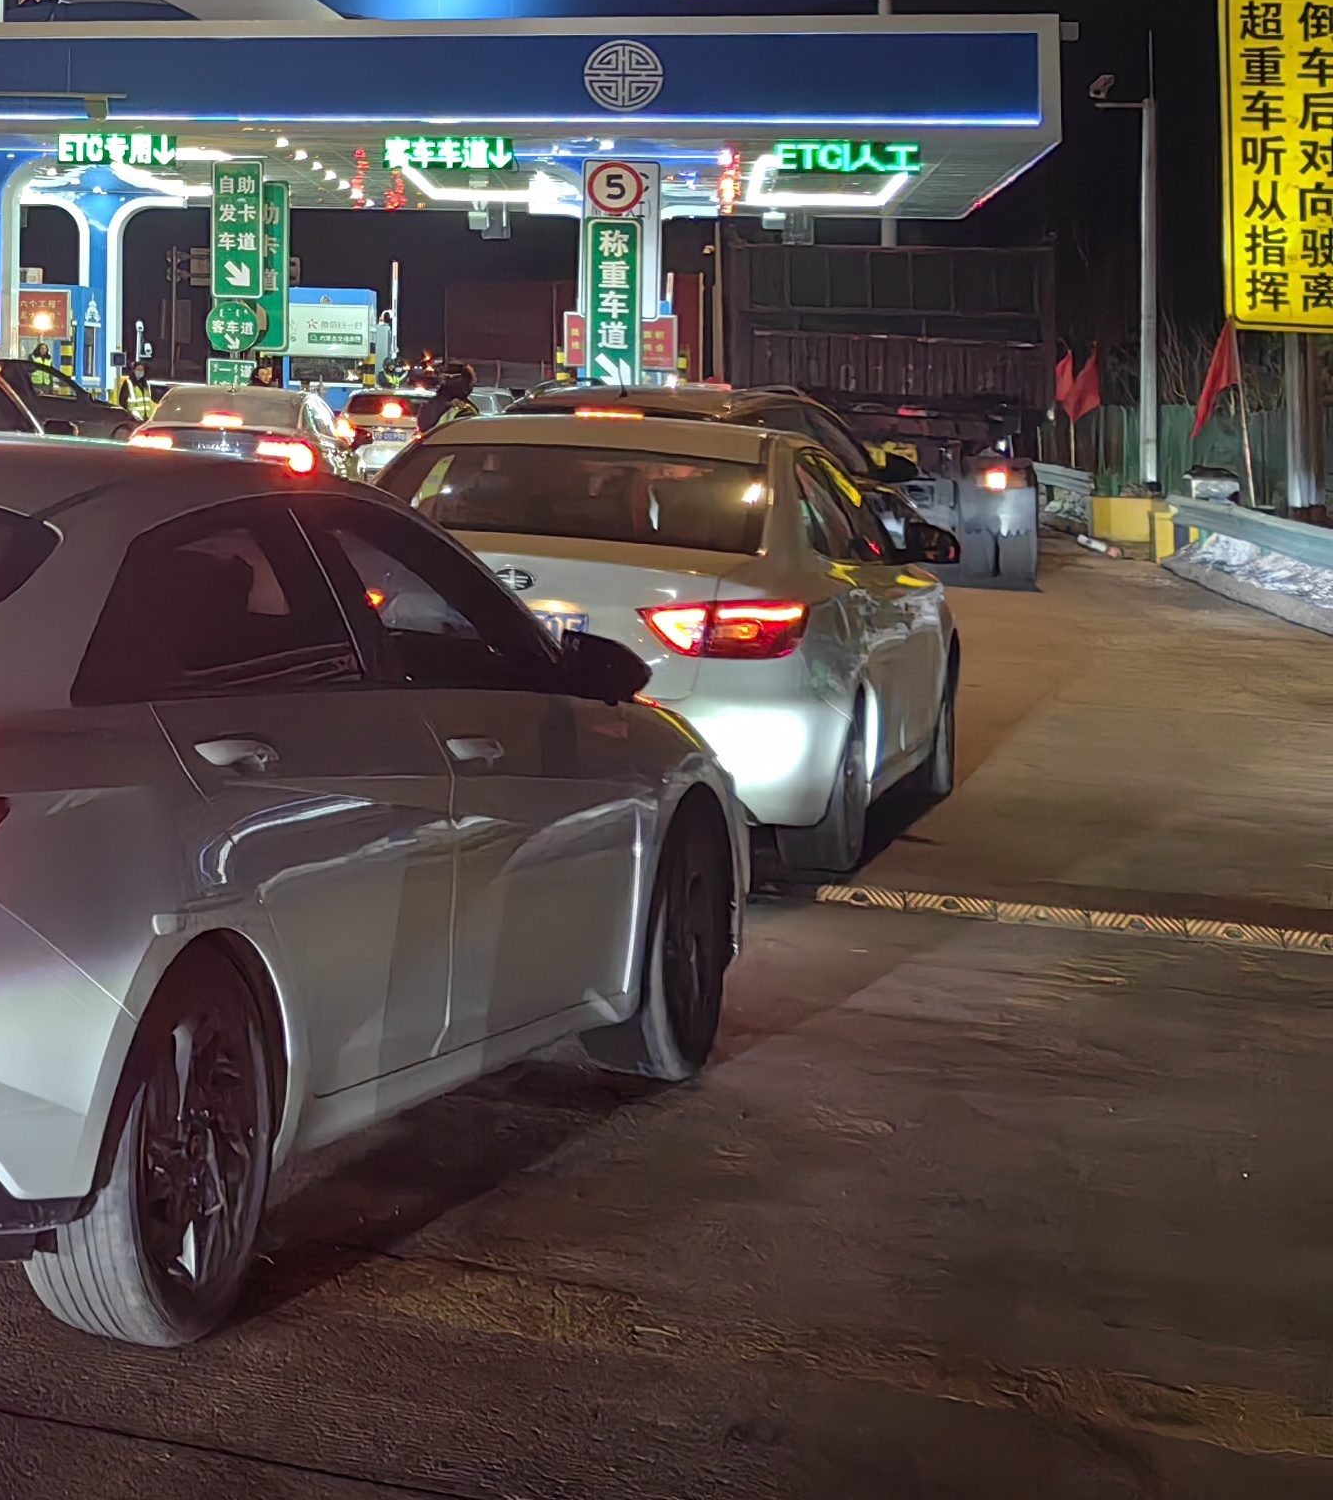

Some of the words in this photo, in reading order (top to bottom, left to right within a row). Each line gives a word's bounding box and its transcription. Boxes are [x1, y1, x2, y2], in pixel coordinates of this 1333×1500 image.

[58, 134, 152, 163] ETC专用
[384, 137, 490, 168] 客车车道
[1240, 1, 1290, 312] 超重车听从指挥
[219, 176, 255, 194] 自助
[606, 174, 626, 200] 5
[219, 204, 257, 223] 发卡
[218, 233, 257, 251] 车道
[597, 229, 630, 350] 称重车道
[211, 320, 254, 336] 客车道
